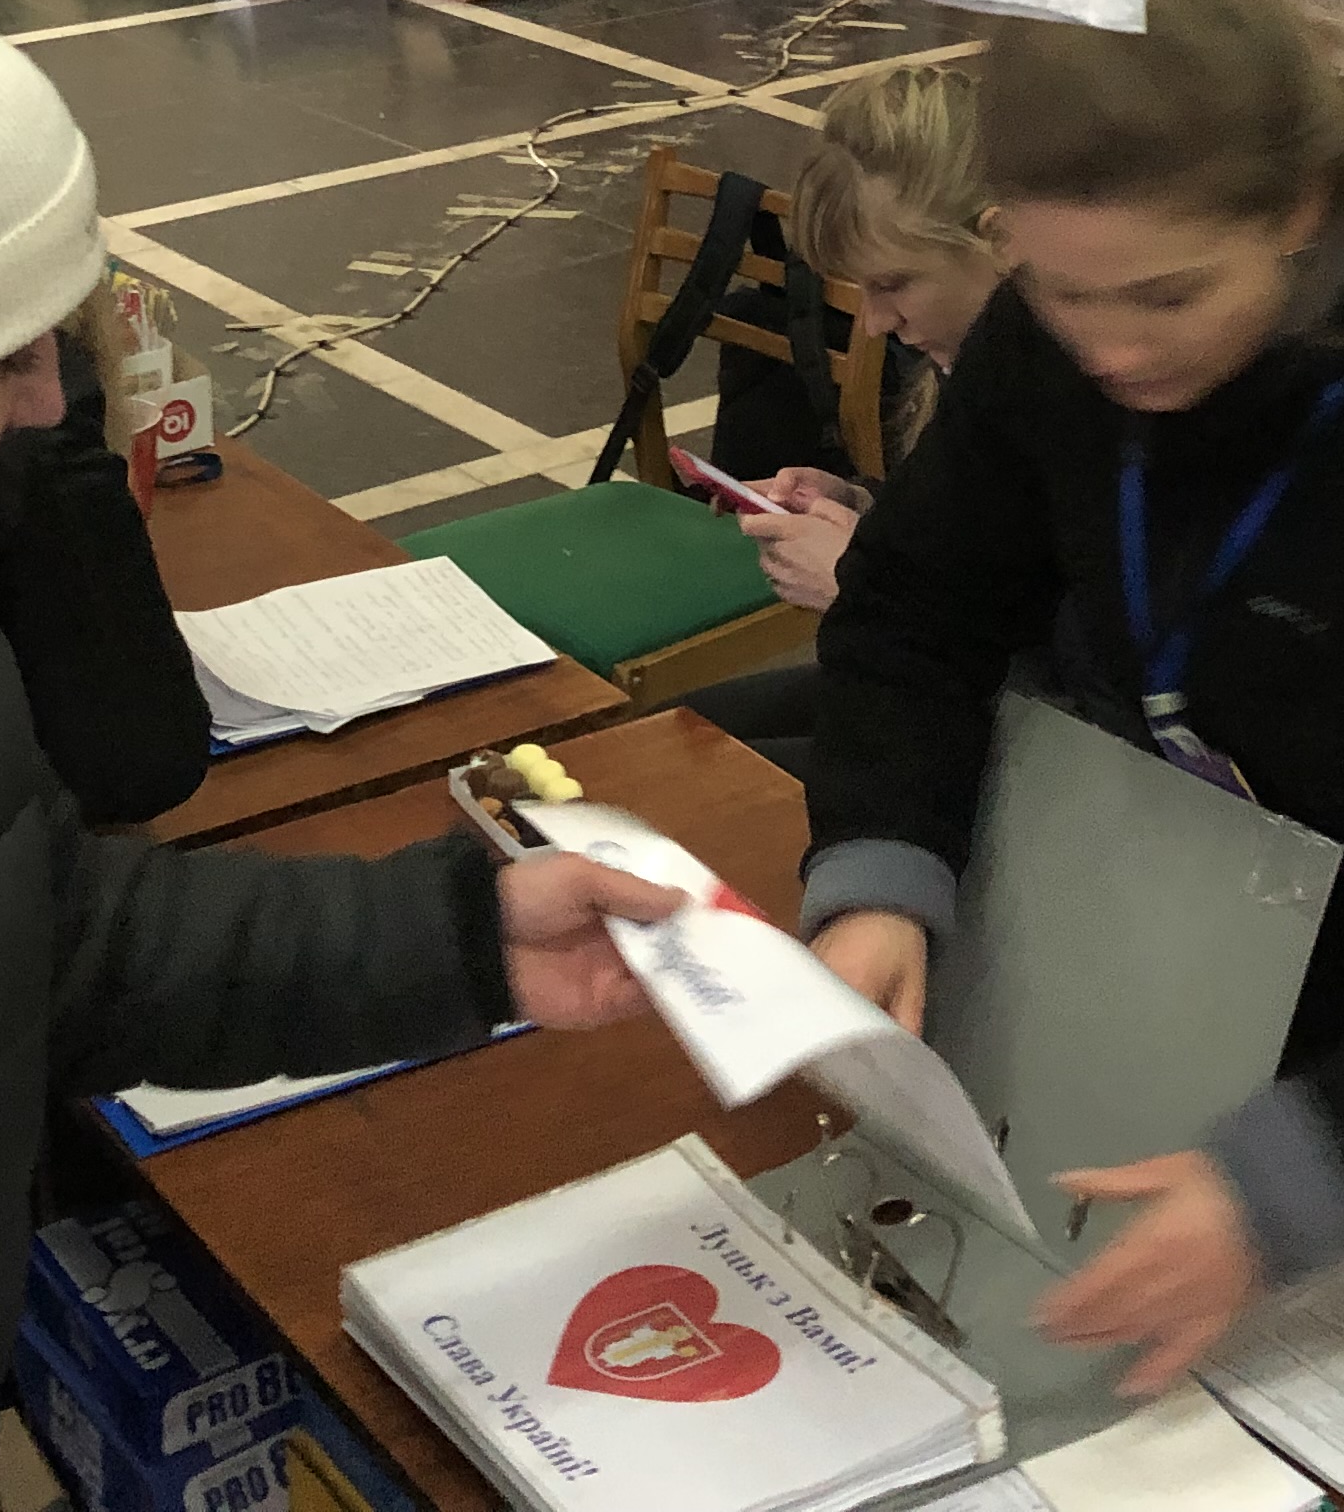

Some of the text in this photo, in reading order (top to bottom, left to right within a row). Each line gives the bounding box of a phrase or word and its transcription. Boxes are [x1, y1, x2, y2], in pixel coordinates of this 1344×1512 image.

[690, 1222, 878, 1375] Луцьк з Вами!
[422, 1314, 600, 1482] Слава Україні!
